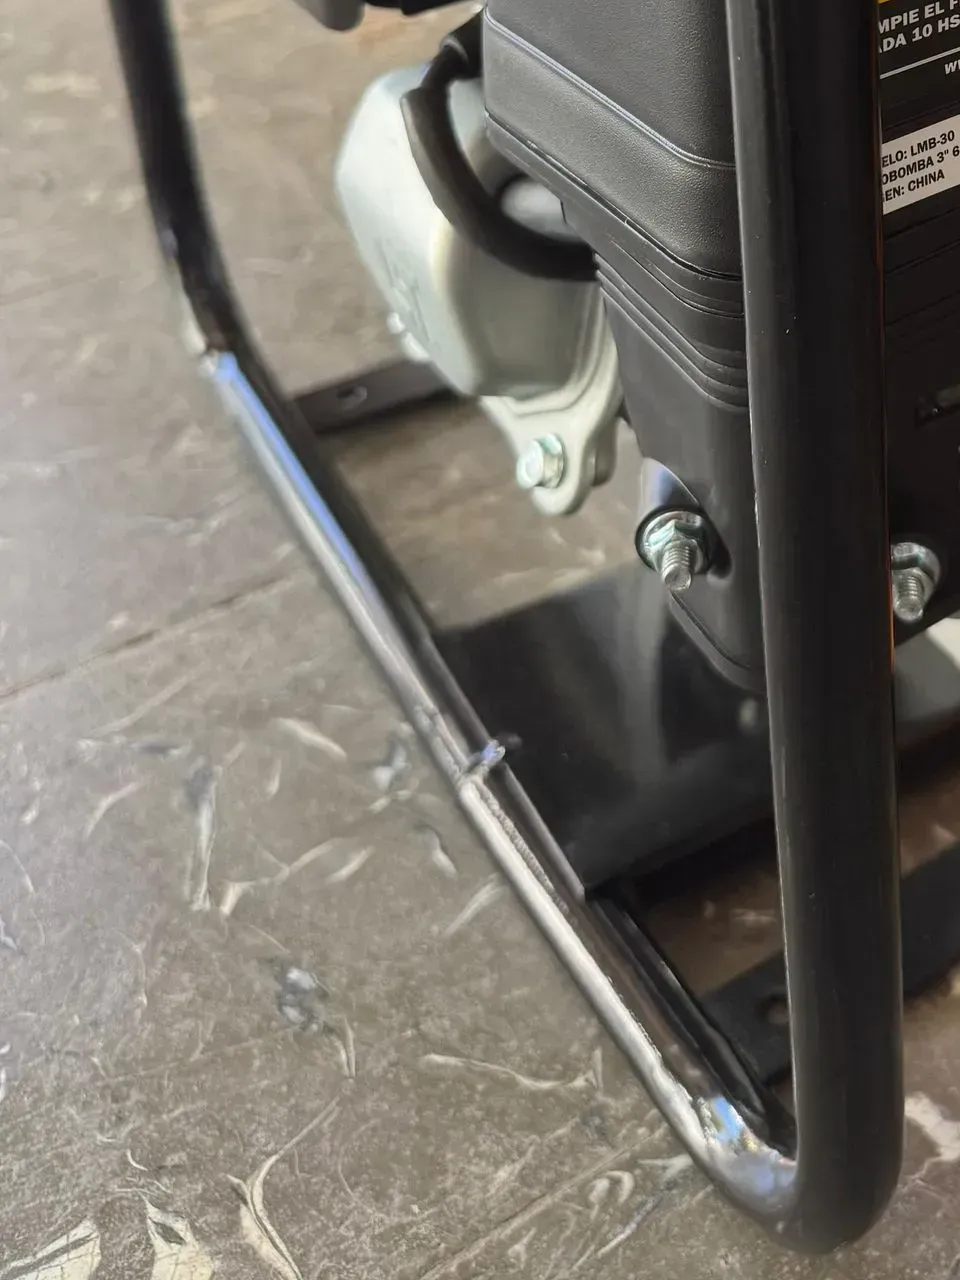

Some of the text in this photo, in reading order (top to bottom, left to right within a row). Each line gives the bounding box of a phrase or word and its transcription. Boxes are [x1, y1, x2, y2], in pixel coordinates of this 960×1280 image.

[924, 1, 945, 19] EL
[911, 23, 933, 42] 10
[937, 14, 960, 33] HS
[881, 130, 955, 169] ELO: LMB-30
[883, 169, 945, 202] EN: CHINA
